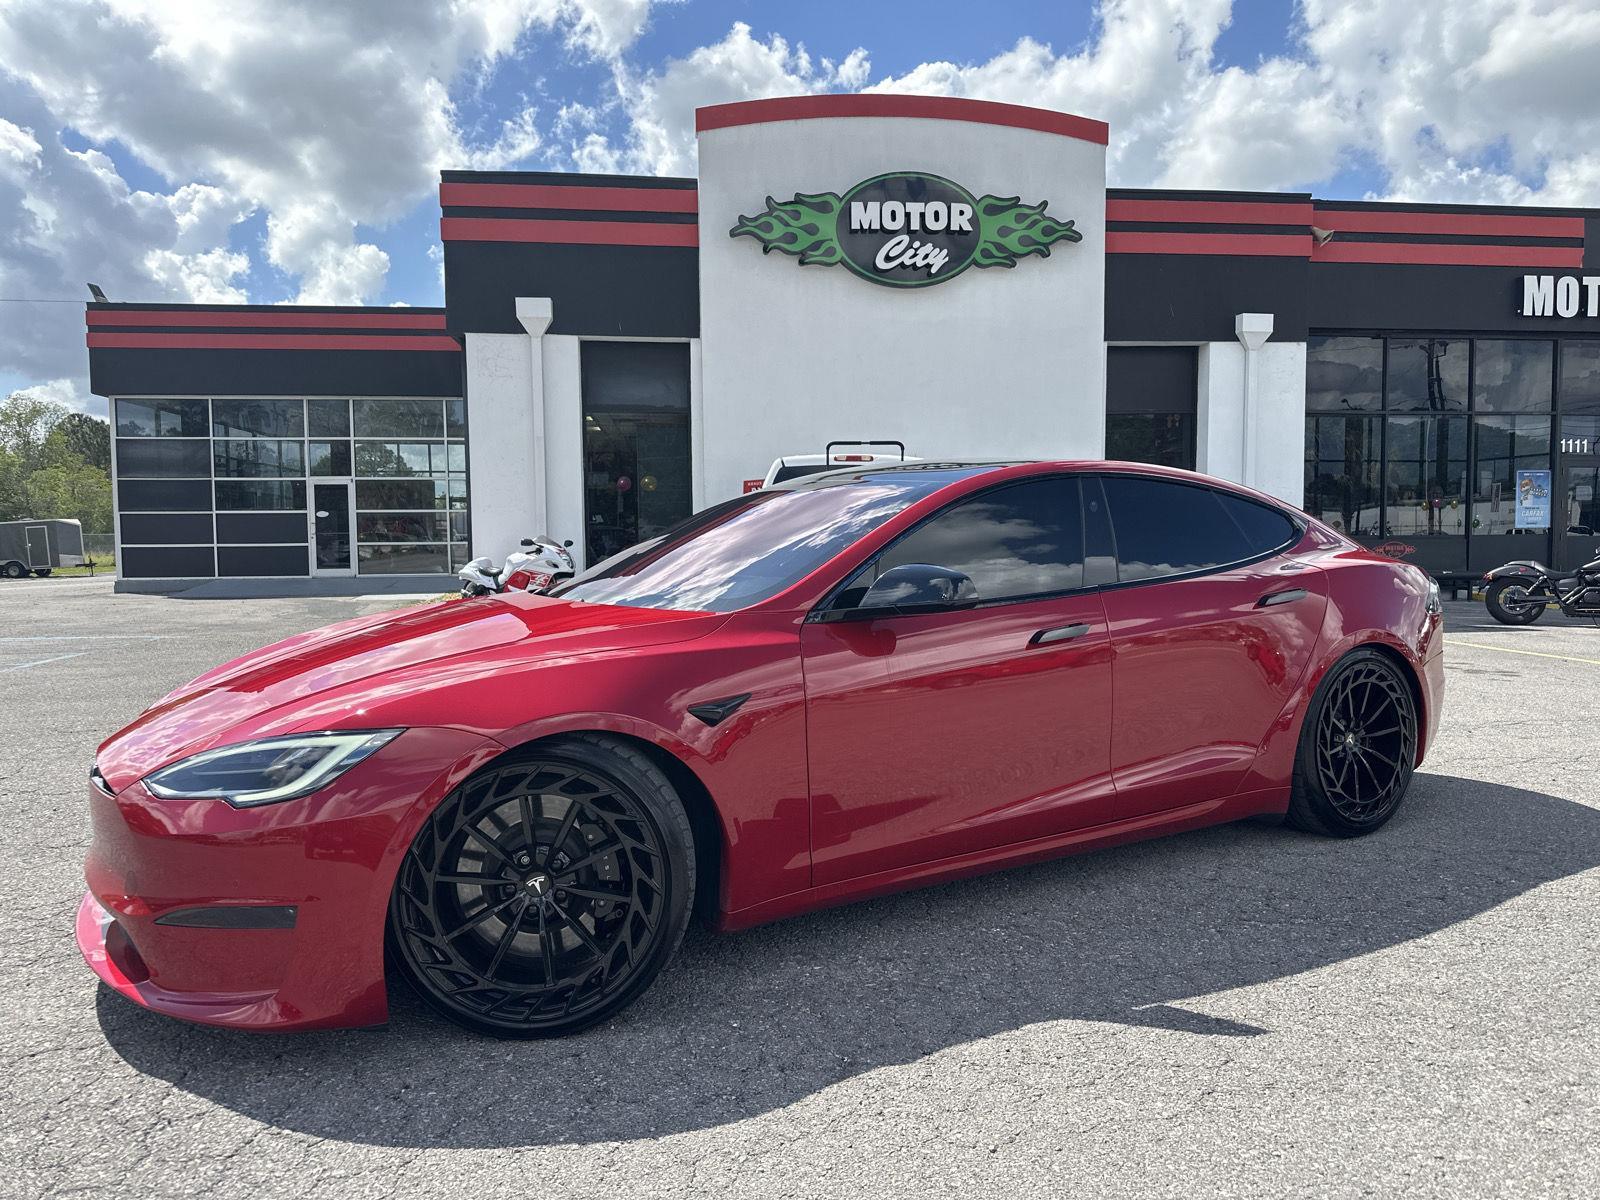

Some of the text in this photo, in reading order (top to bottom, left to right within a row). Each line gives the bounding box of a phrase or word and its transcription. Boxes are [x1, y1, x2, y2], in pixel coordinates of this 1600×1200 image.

[850, 200, 974, 232] MOTOR
[874, 234, 950, 275] City
[1522, 274, 1600, 318] MOT
[1560, 438, 1588, 454] 1111
